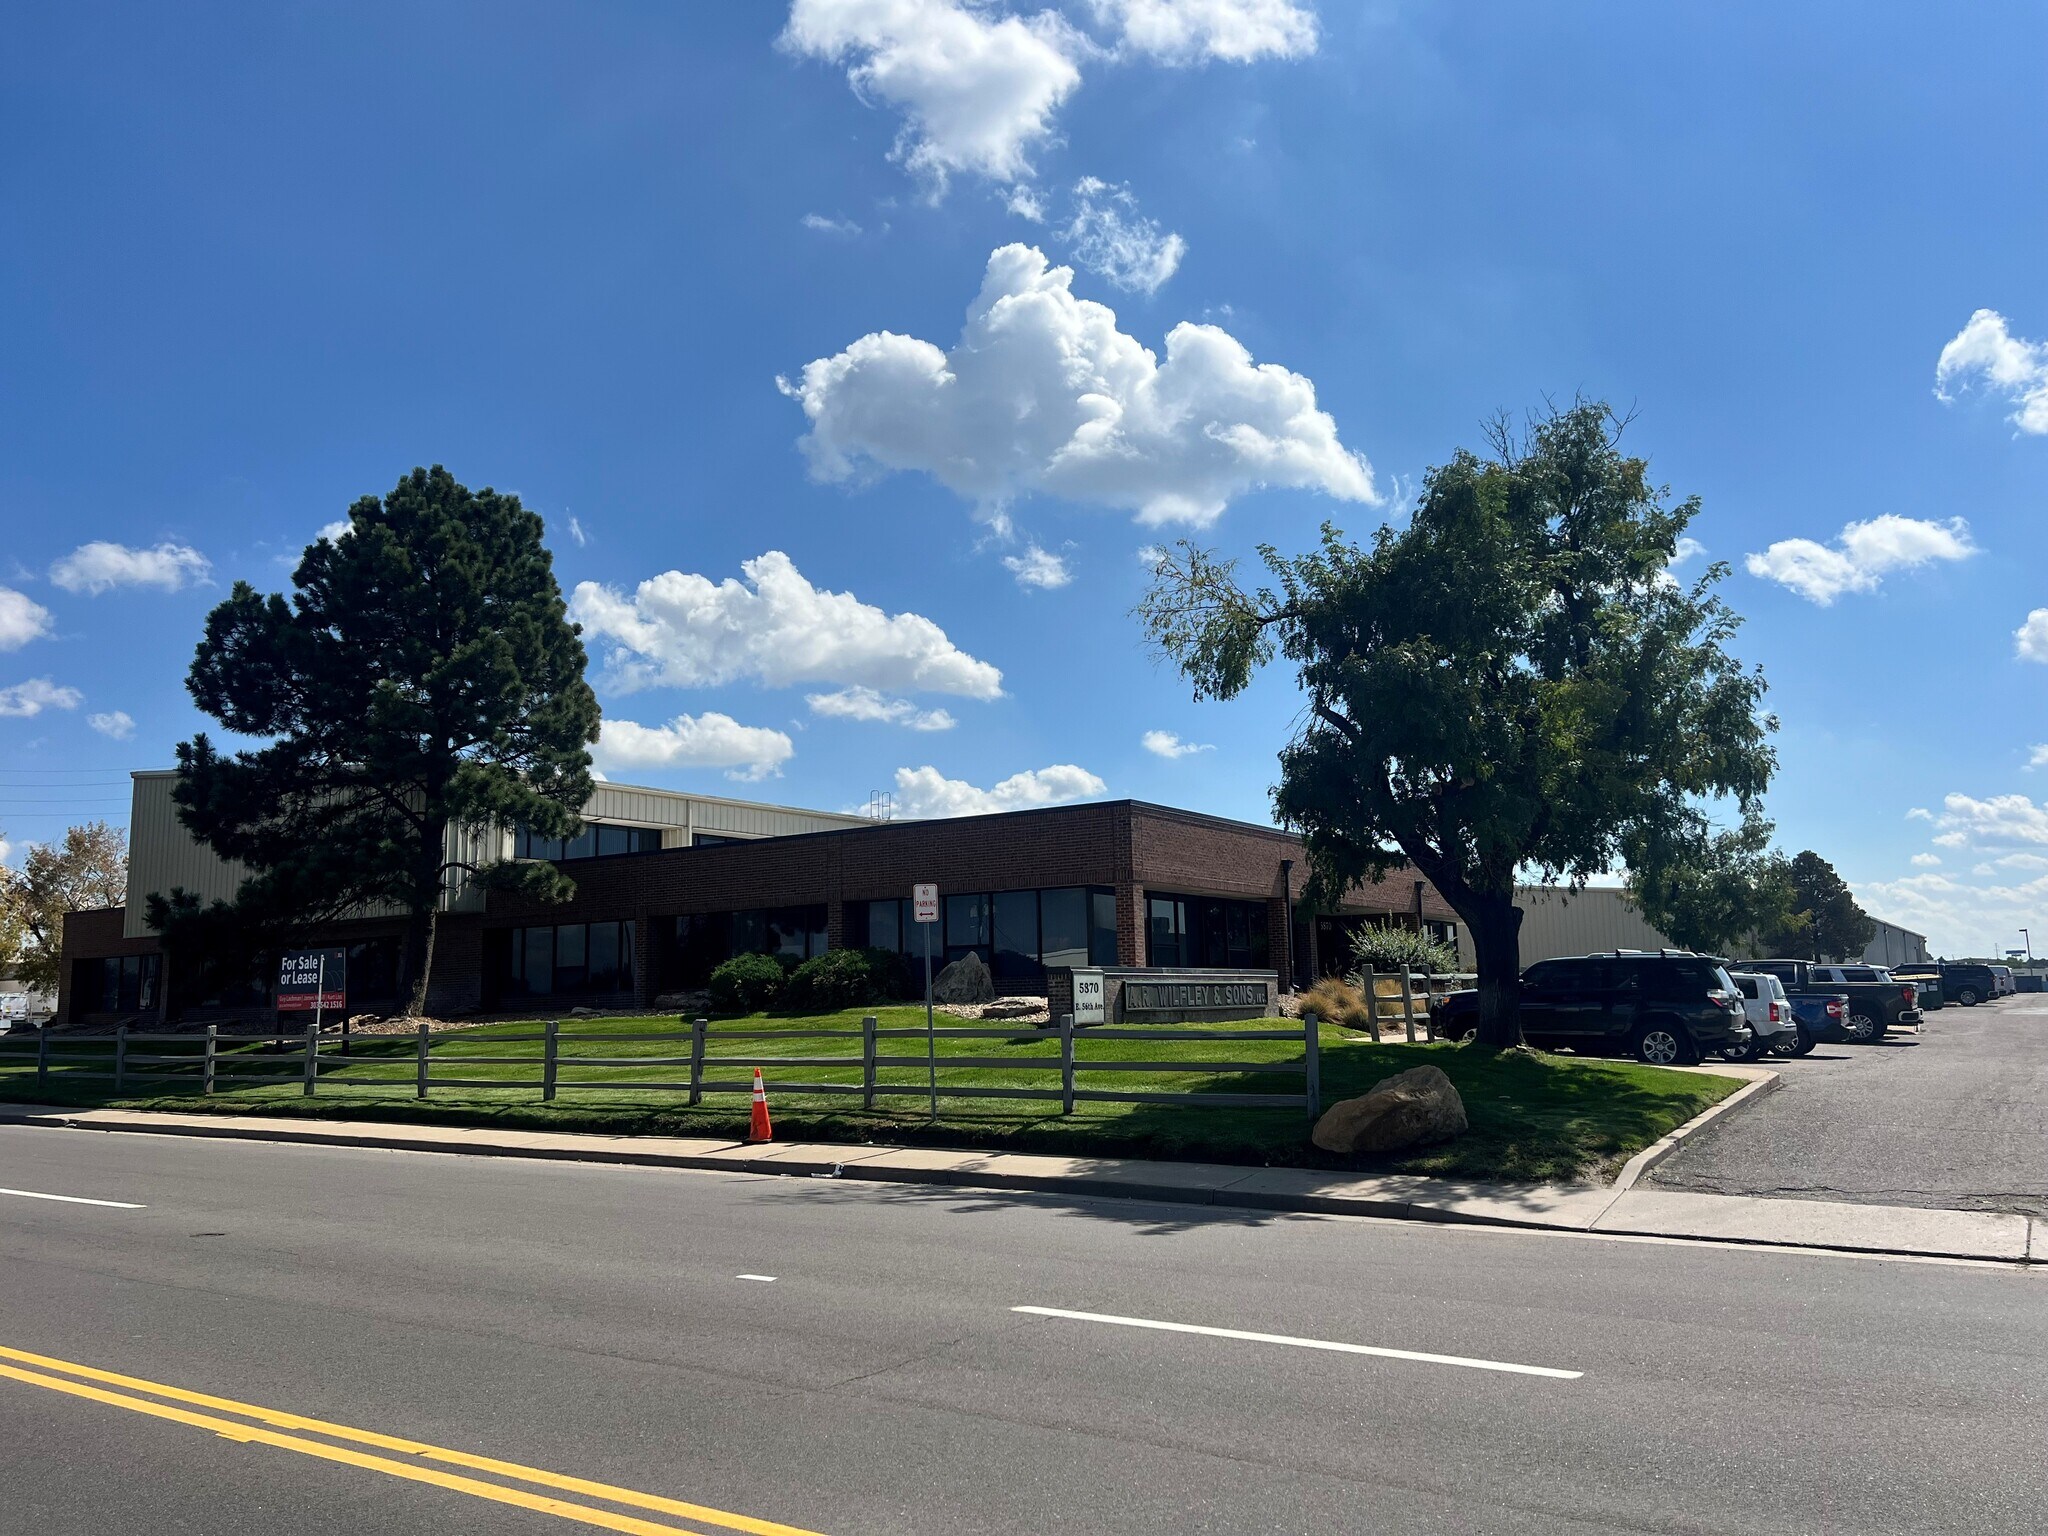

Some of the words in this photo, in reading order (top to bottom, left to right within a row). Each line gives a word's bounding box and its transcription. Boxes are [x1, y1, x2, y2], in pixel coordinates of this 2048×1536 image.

[281, 957, 297, 971] For
[298, 955, 318, 970] Sale
[280, 974, 291, 985] or
[292, 971, 318, 985] Lease
[1079, 982, 1099, 994] 5870
[1128, 986, 1153, 1008] A.R.
[1157, 985, 1210, 1007] WILFLEY
[1213, 985, 1222, 1005] &
[330, 1000, 343, 1009] 1516
[1082, 1002, 1094, 1010] 56th
